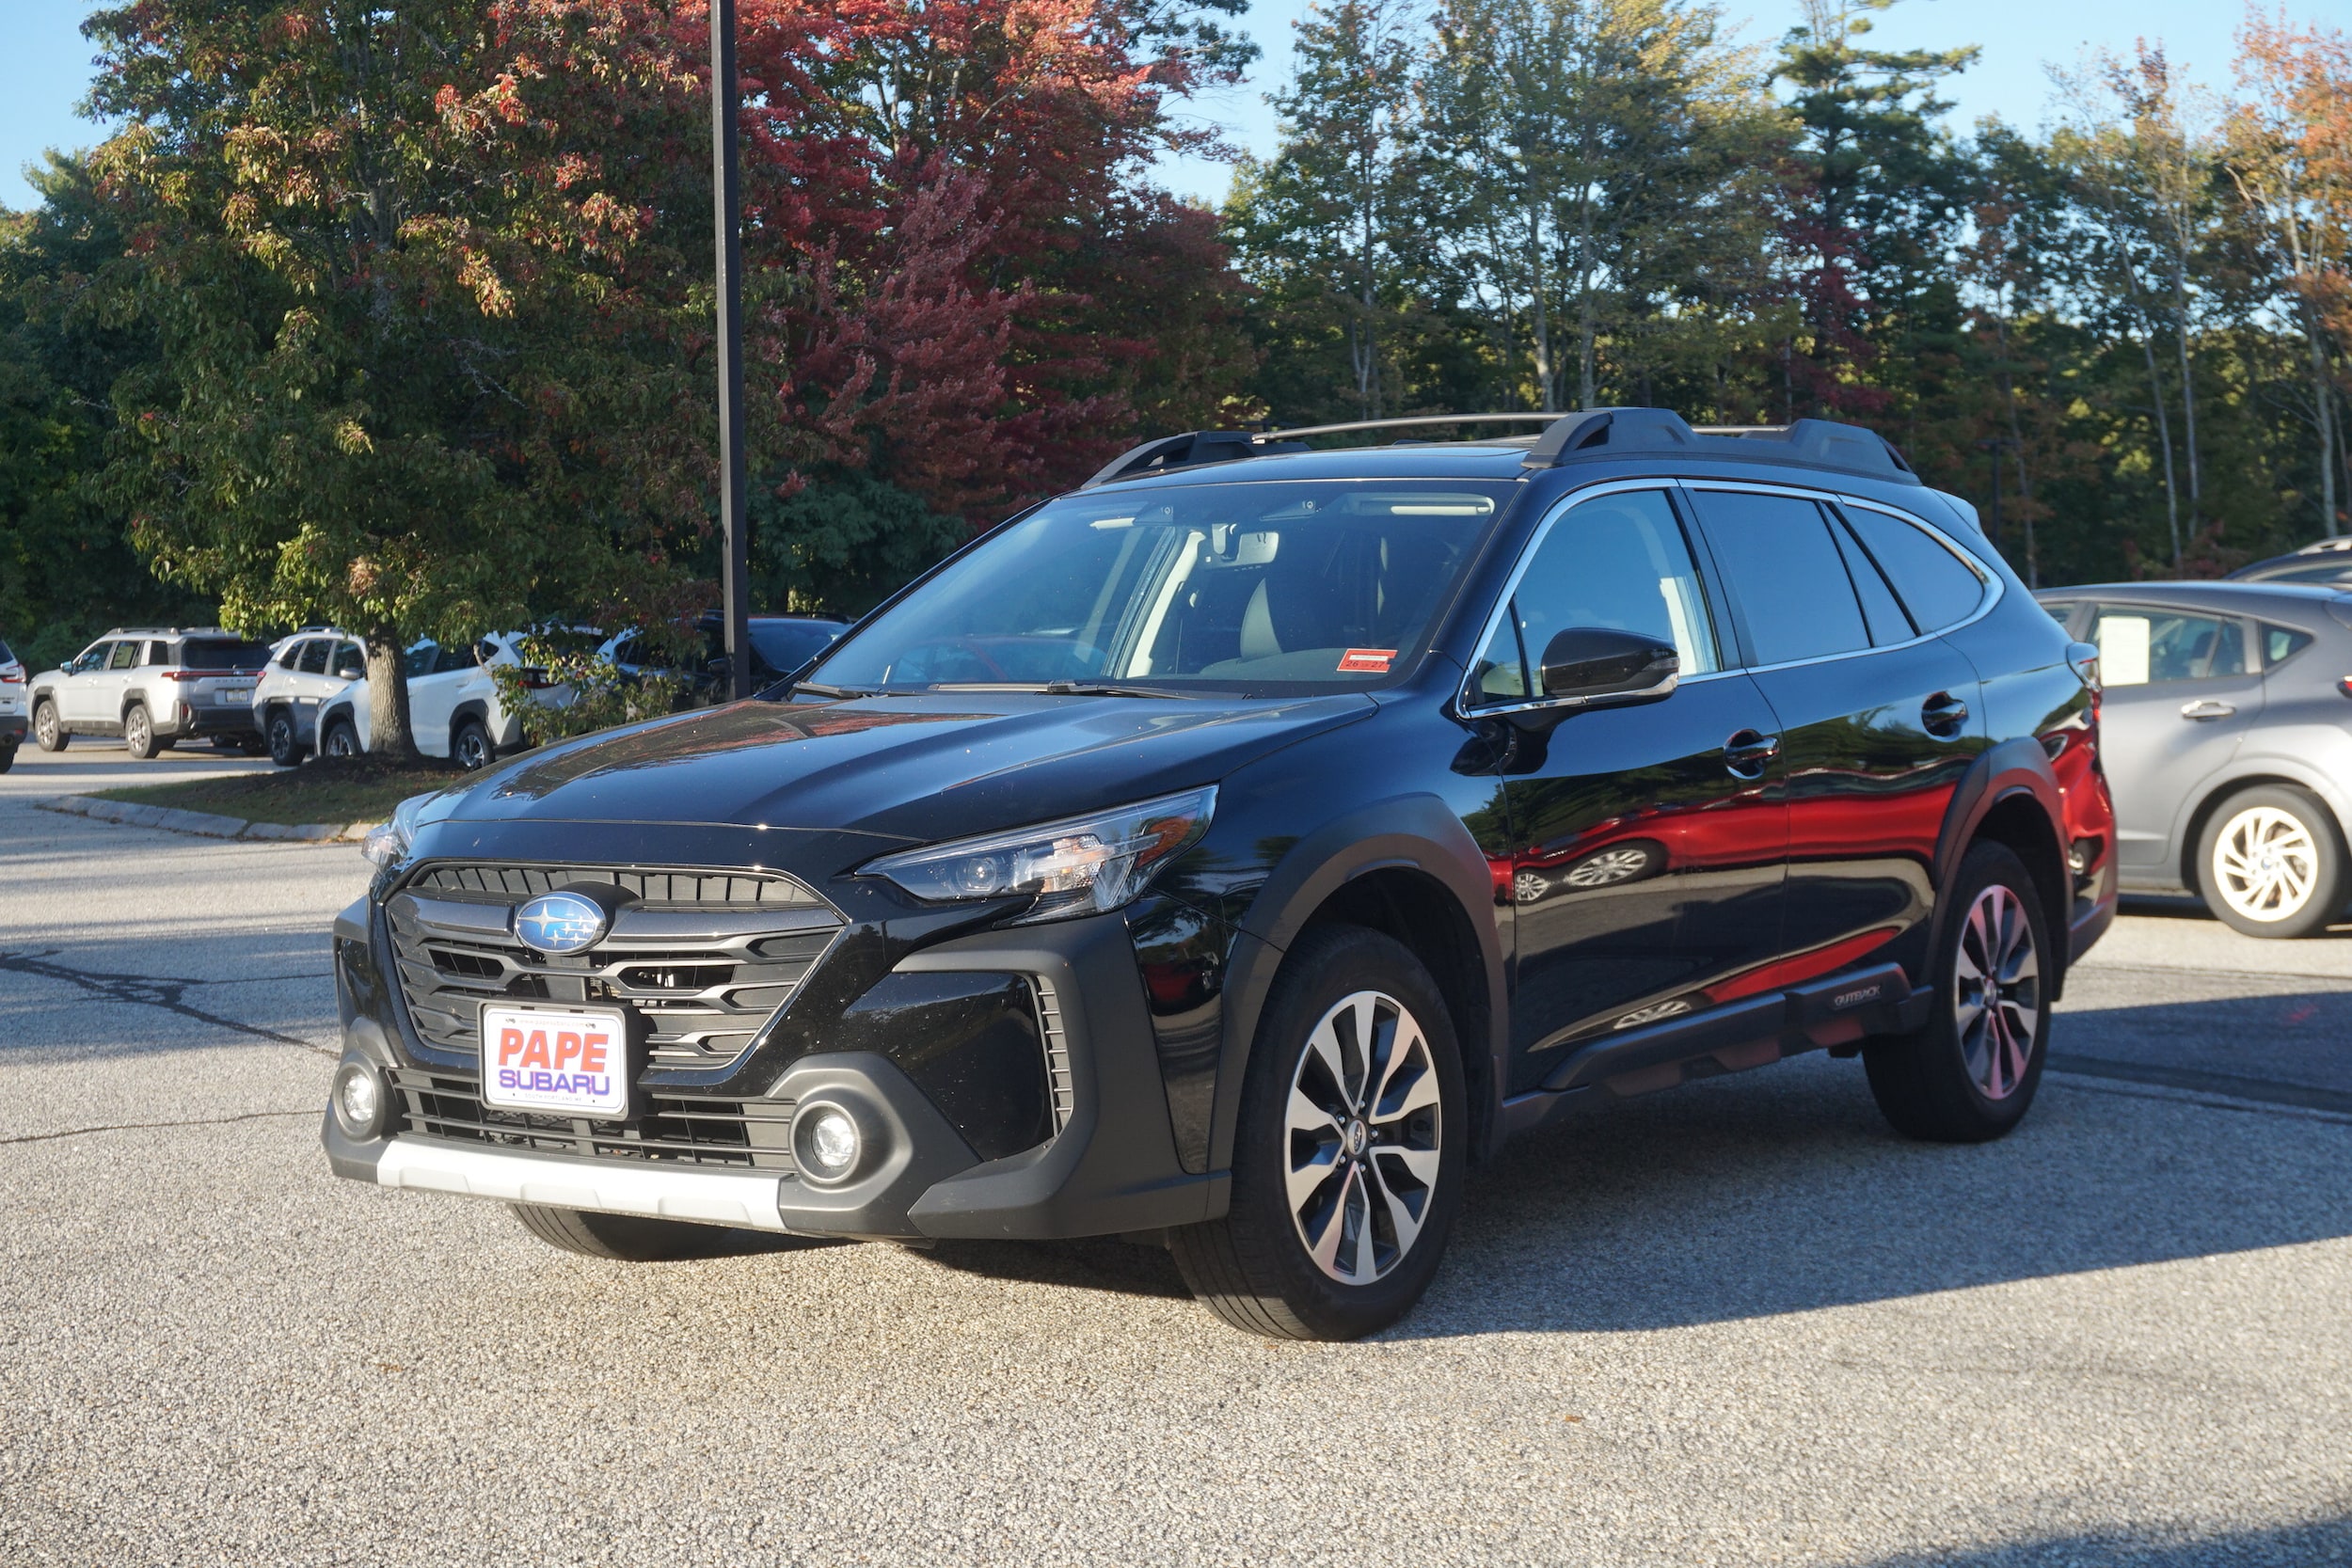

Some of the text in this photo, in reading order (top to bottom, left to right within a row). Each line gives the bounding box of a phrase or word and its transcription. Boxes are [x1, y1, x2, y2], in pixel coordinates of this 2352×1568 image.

[1834, 985, 1882, 1006] OUTBACK
[498, 1028, 609, 1073] PAPE
[499, 1069, 610, 1096] SUBARU
